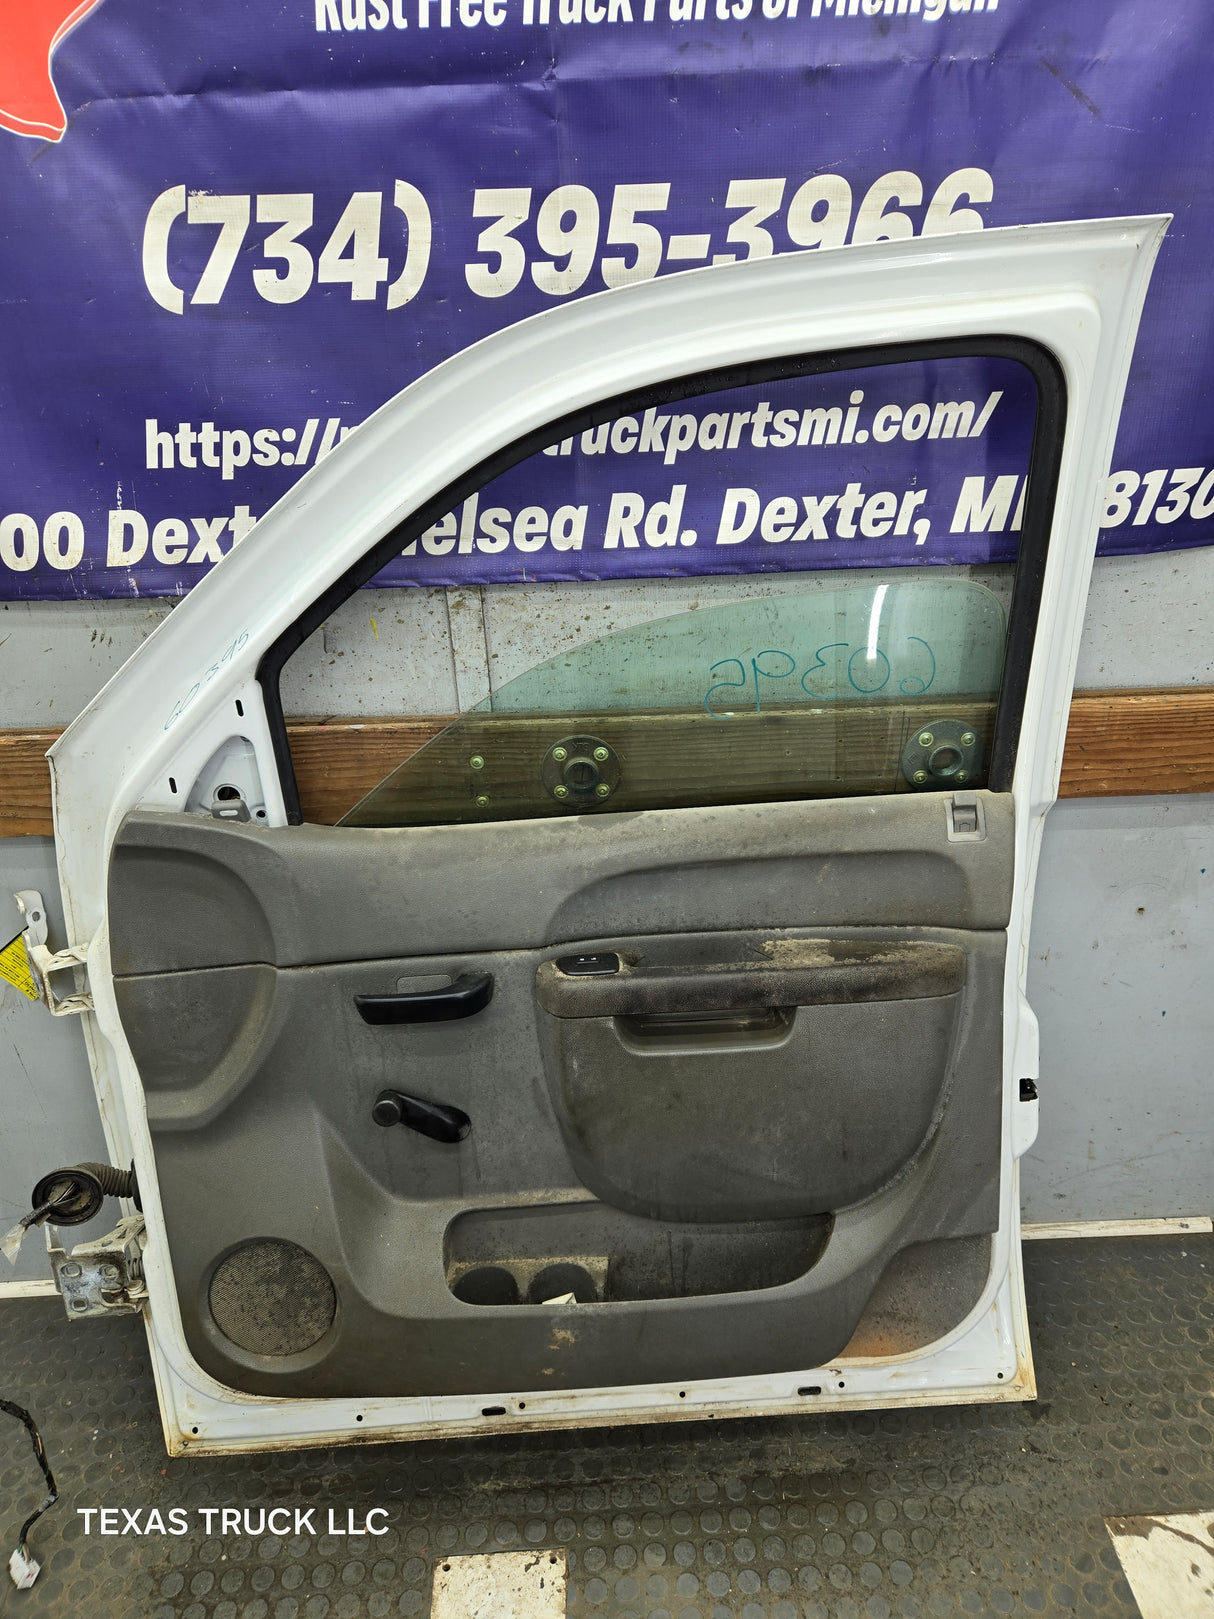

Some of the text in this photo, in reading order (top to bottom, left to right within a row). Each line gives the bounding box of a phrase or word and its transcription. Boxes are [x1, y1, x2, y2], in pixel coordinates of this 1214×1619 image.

[142, 167, 994, 315] (734) 395-3966
[542, 389, 1004, 465] uckpartsmi.com/
[0, 511, 85, 572] 00
[603, 484, 698, 549] Rd.
[716, 482, 931, 546] Dexter,
